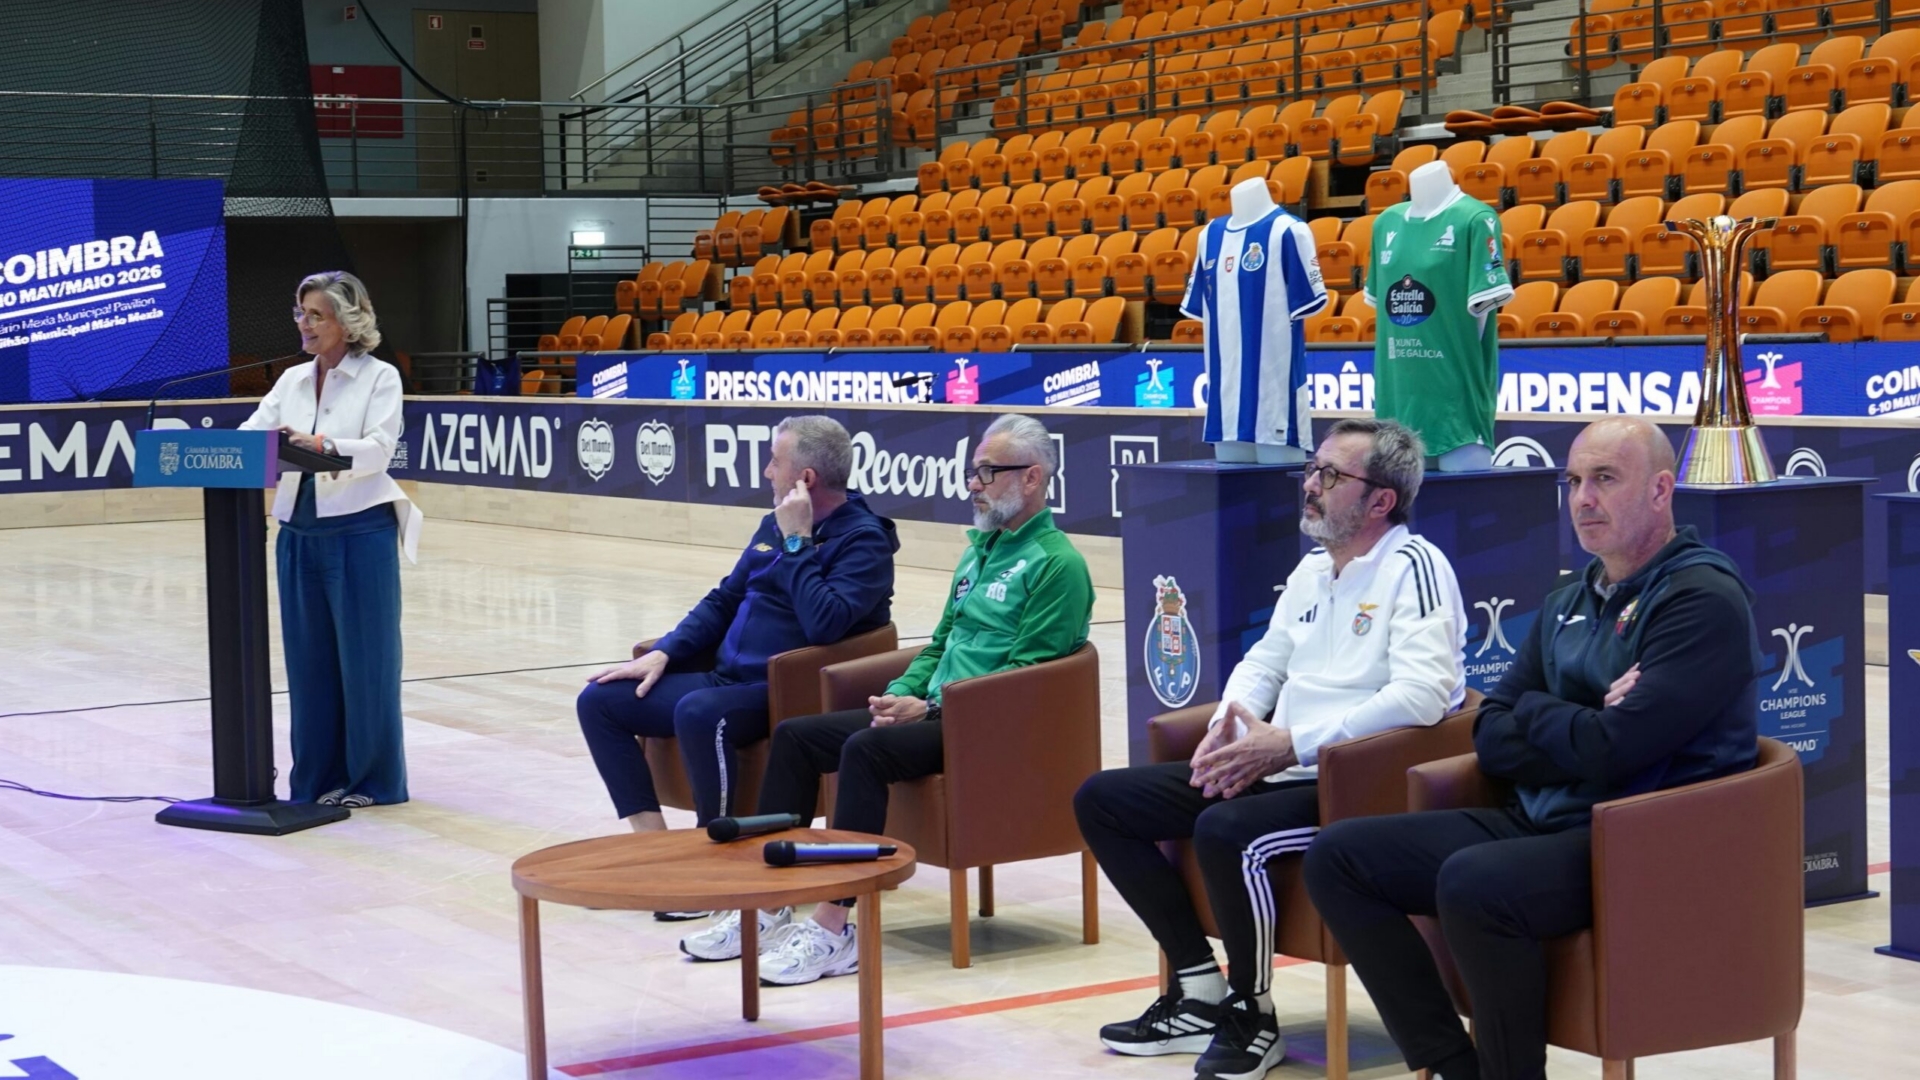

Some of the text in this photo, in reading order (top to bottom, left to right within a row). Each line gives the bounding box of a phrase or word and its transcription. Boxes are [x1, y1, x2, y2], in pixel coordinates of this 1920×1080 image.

[0, 230, 164, 285] OIMBRA
[19, 275, 115, 304] MAY/MAIO
[117, 264, 162, 285] 2026
[1390, 289, 1424, 301] Estrella
[57, 303, 112, 324] Municipal
[113, 297, 155, 313] Pavilion
[1391, 301, 1423, 314] Galicia
[30, 321, 91, 343] Municipal
[91, 315, 127, 331] Mário
[127, 307, 164, 324] Mexia
[1396, 338, 1422, 347] XUNTA
[1406, 348, 1444, 358] GALICIA
[592, 361, 628, 387] COIMBRA
[1043, 360, 1101, 393] COIMBRA
[705, 371, 772, 400] PRESS
[1868, 400, 1892, 415] 6-10
[420, 412, 553, 478] AZEMAD
[591, 438, 611, 453] Monte
[651, 441, 672, 456] Monte
[183, 454, 244, 469] COIMBRA
[705, 424, 779, 489] RT
[847, 431, 971, 501] Record
[1760, 693, 1827, 711] CHAMPIONS
[1780, 709, 1807, 720] LEAGUE
